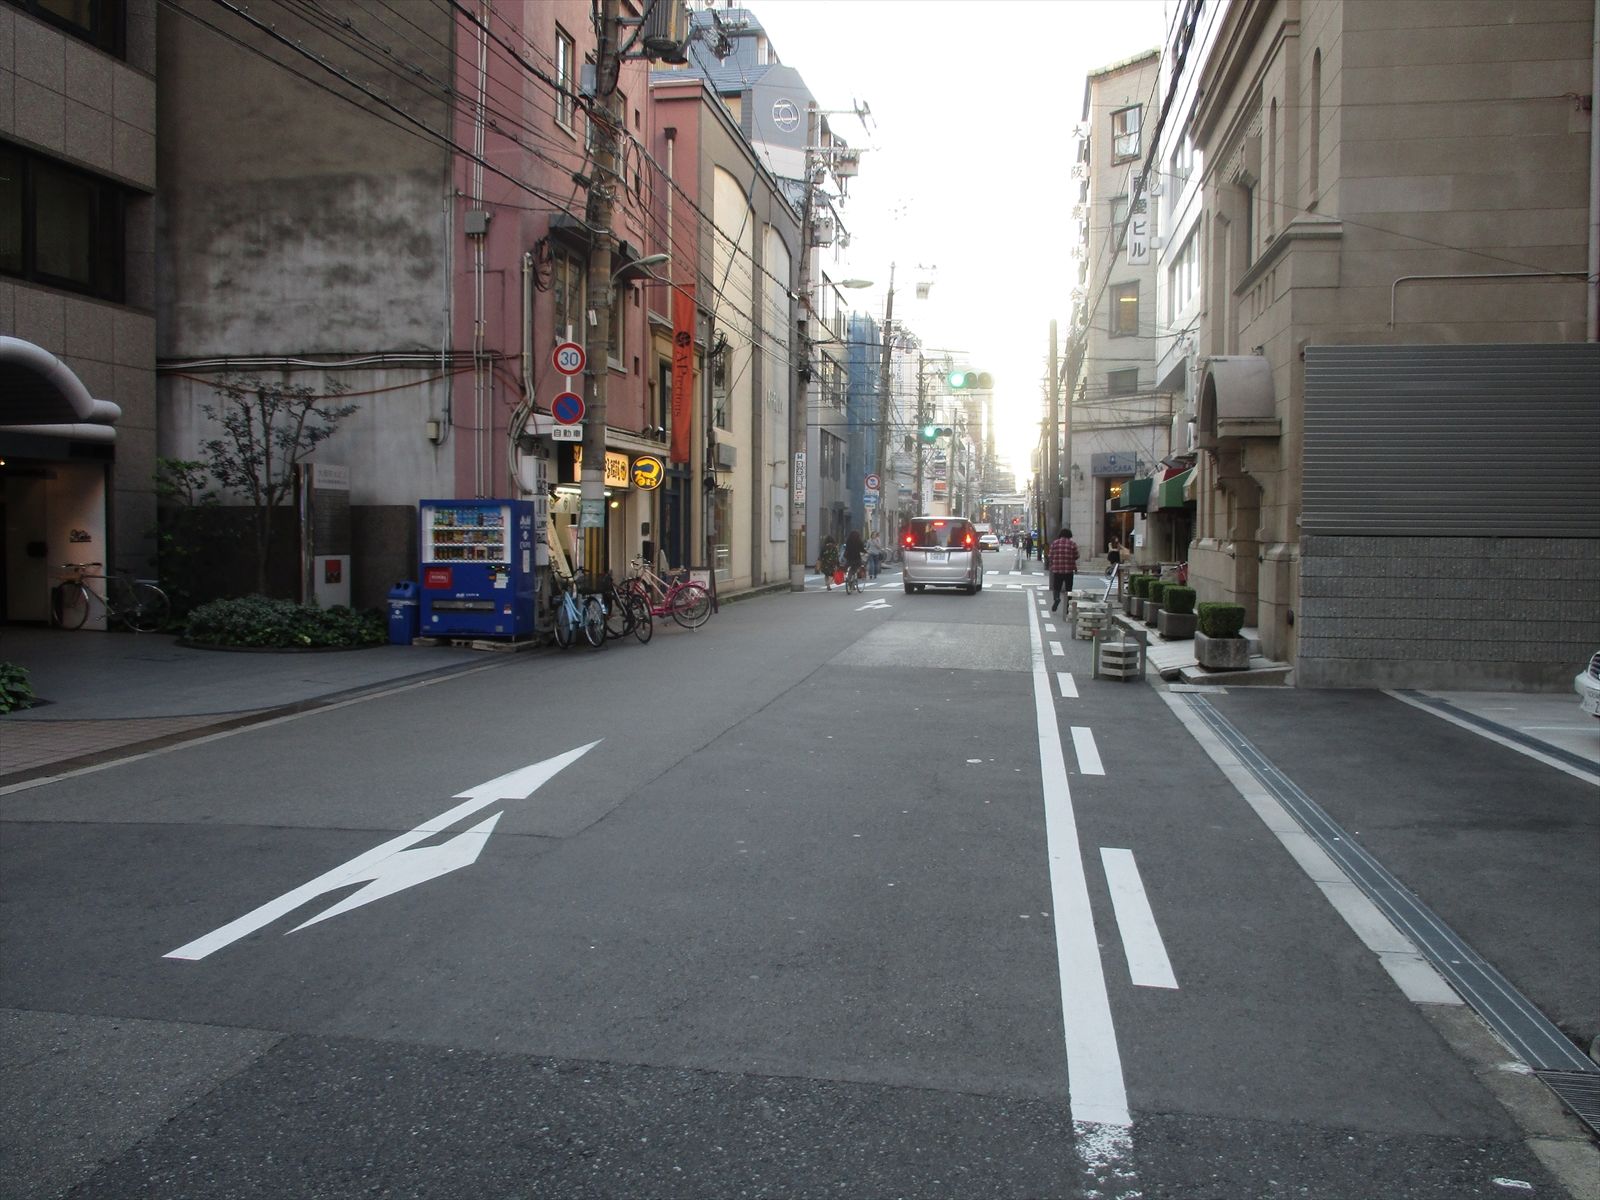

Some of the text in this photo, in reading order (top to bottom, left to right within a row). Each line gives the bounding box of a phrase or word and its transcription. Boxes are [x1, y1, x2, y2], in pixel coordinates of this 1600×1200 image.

[560, 351, 579, 367] 30
[553, 428, 581, 438] 自動車
